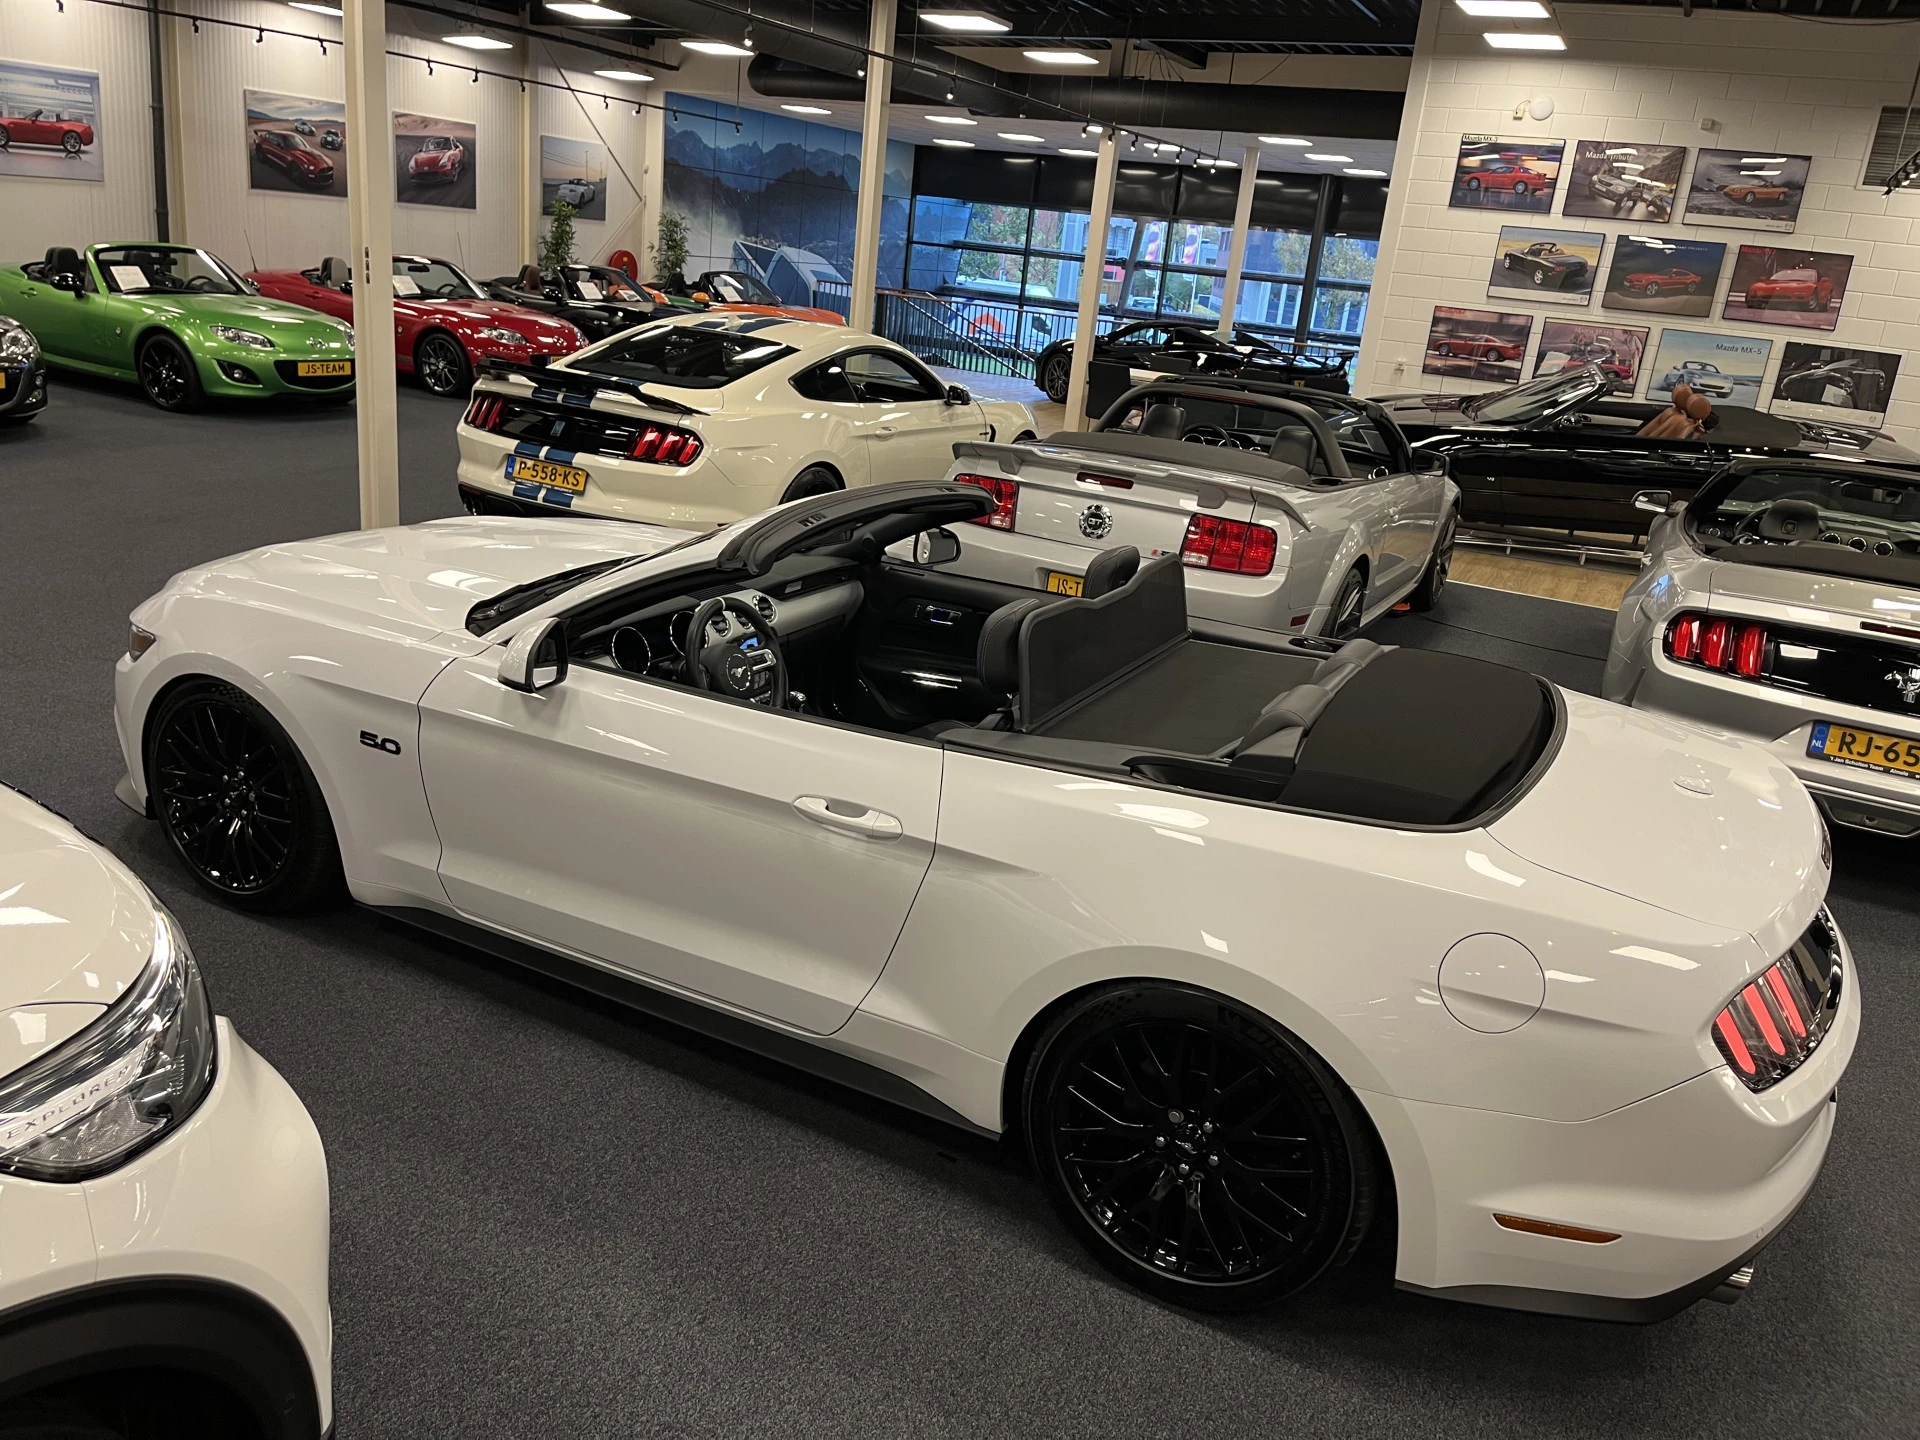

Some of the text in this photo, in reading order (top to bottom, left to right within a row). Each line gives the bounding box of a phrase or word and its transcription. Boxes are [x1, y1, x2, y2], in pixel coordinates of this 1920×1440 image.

[1586, 151, 1608, 160] Mazda
[1715, 343, 1763, 355] Mazda MX-5
[305, 363, 345, 375] JS-TEAM
[517, 460, 581, 487] P-558-KS
[360, 729, 402, 755] 5.0
[1811, 739, 1824, 748] NL
[1845, 758, 1869, 769] Scholten
[1869, 763, 1884, 772] Team
[1890, 768, 1909, 777] Almelo
[6, 1065, 133, 1141] EXPLORER
